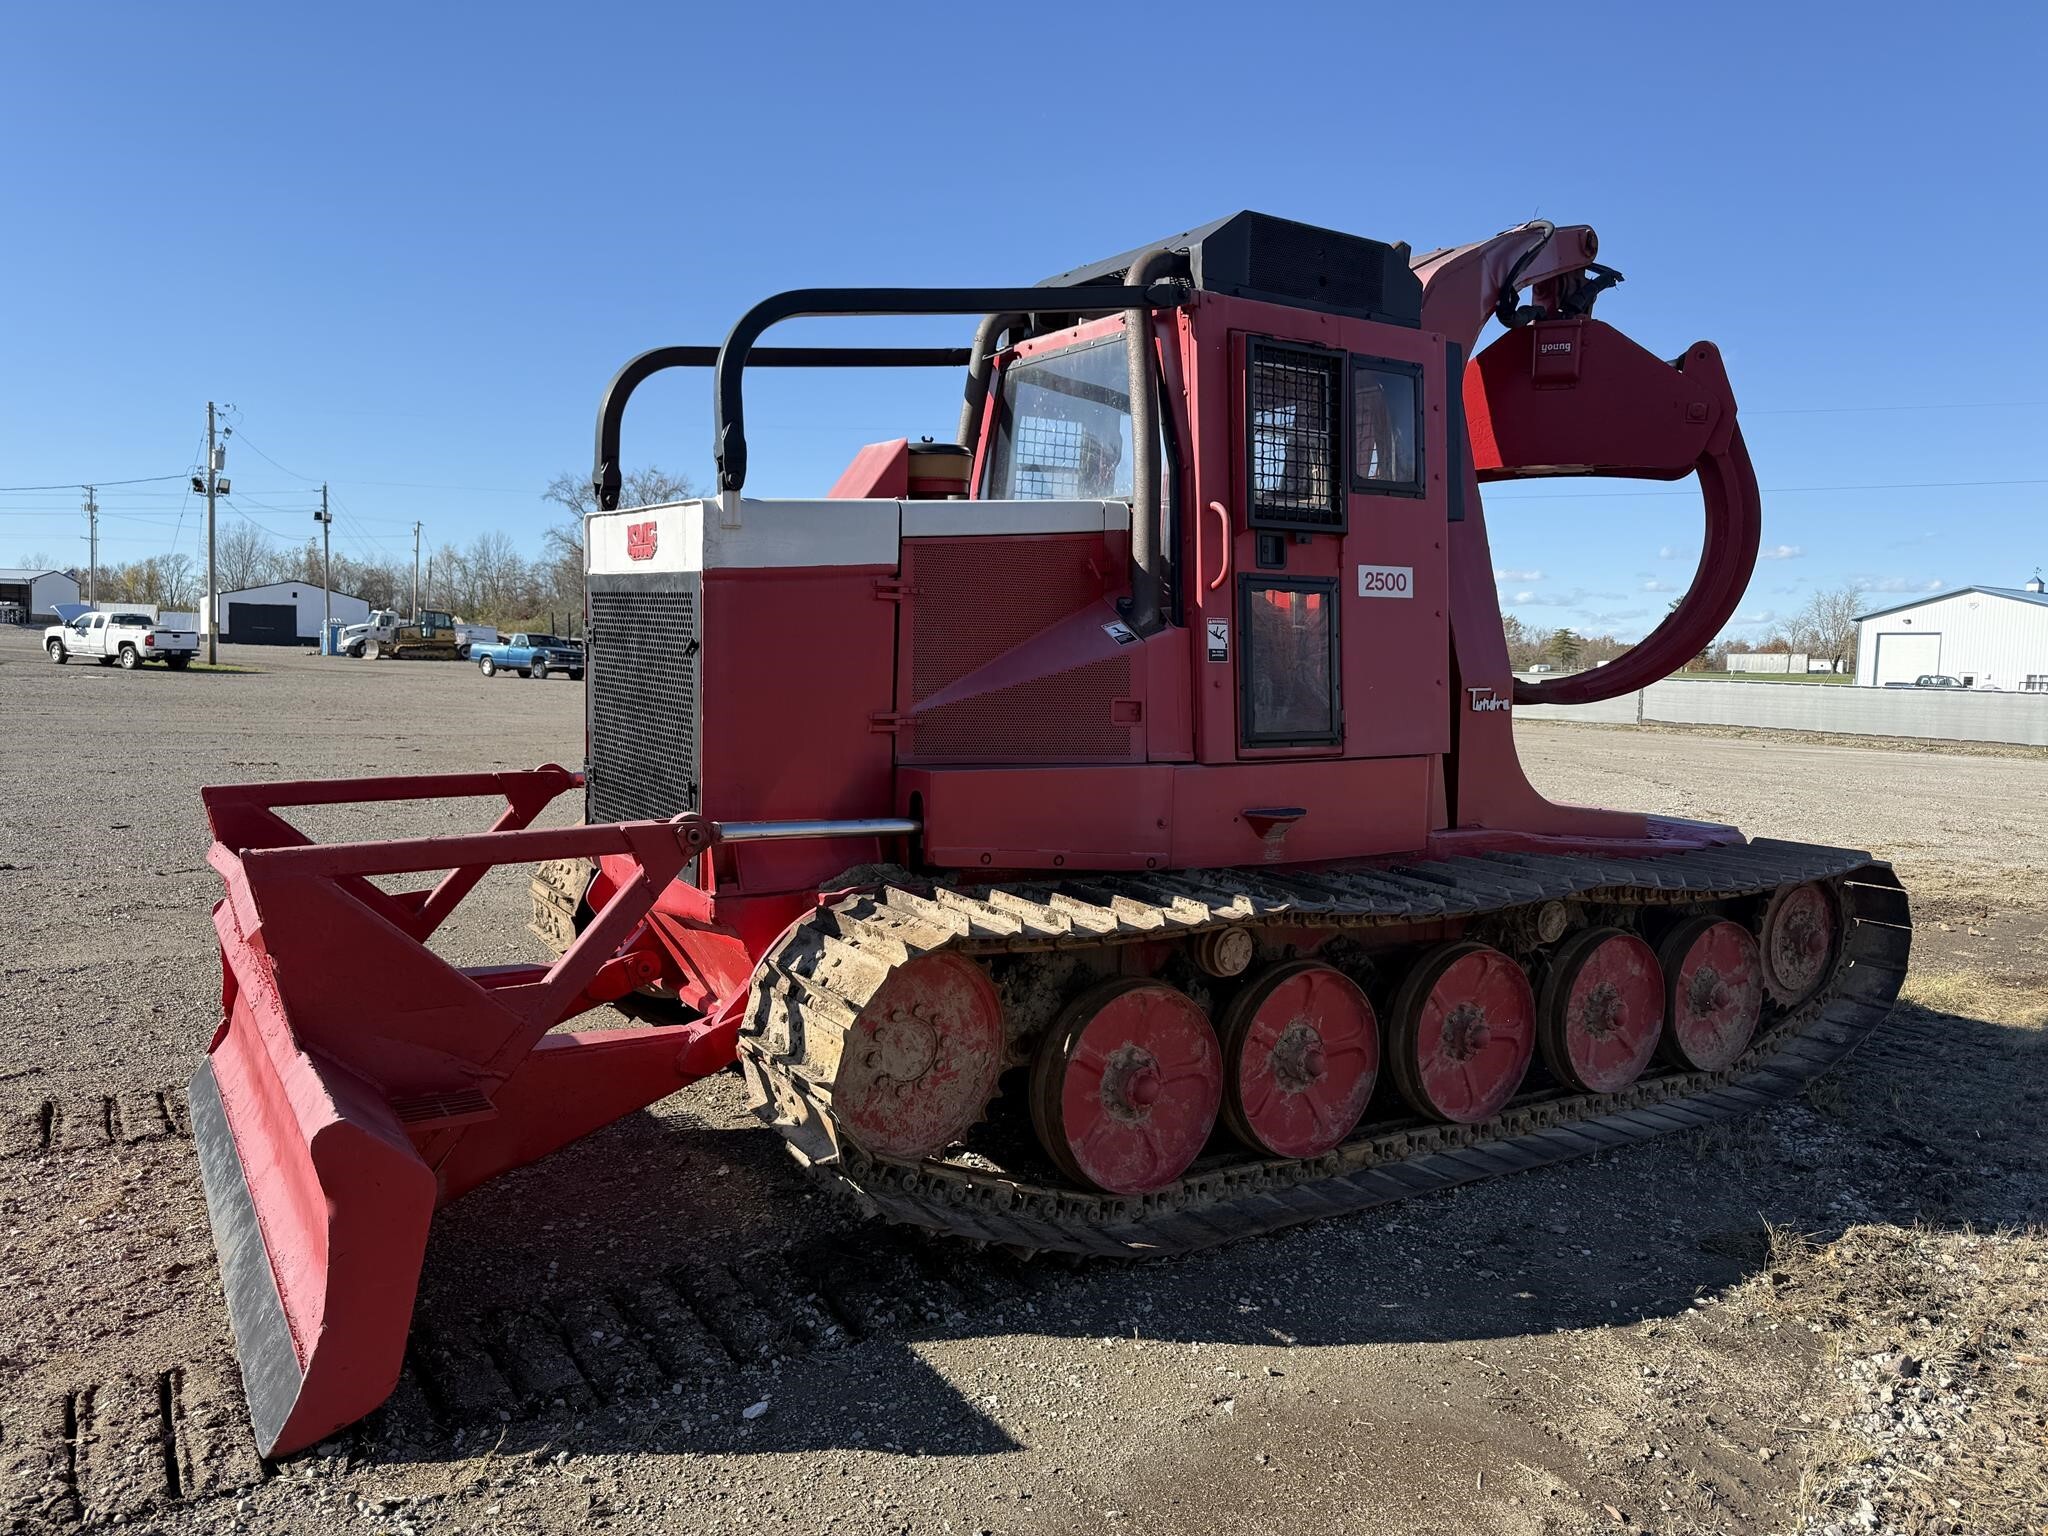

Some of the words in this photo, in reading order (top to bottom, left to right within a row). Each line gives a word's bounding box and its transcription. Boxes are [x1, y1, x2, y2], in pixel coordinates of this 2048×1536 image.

[1541, 342, 1571, 354] young
[1365, 571, 1407, 592] 2500
[1467, 687, 1510, 711] Tundra
